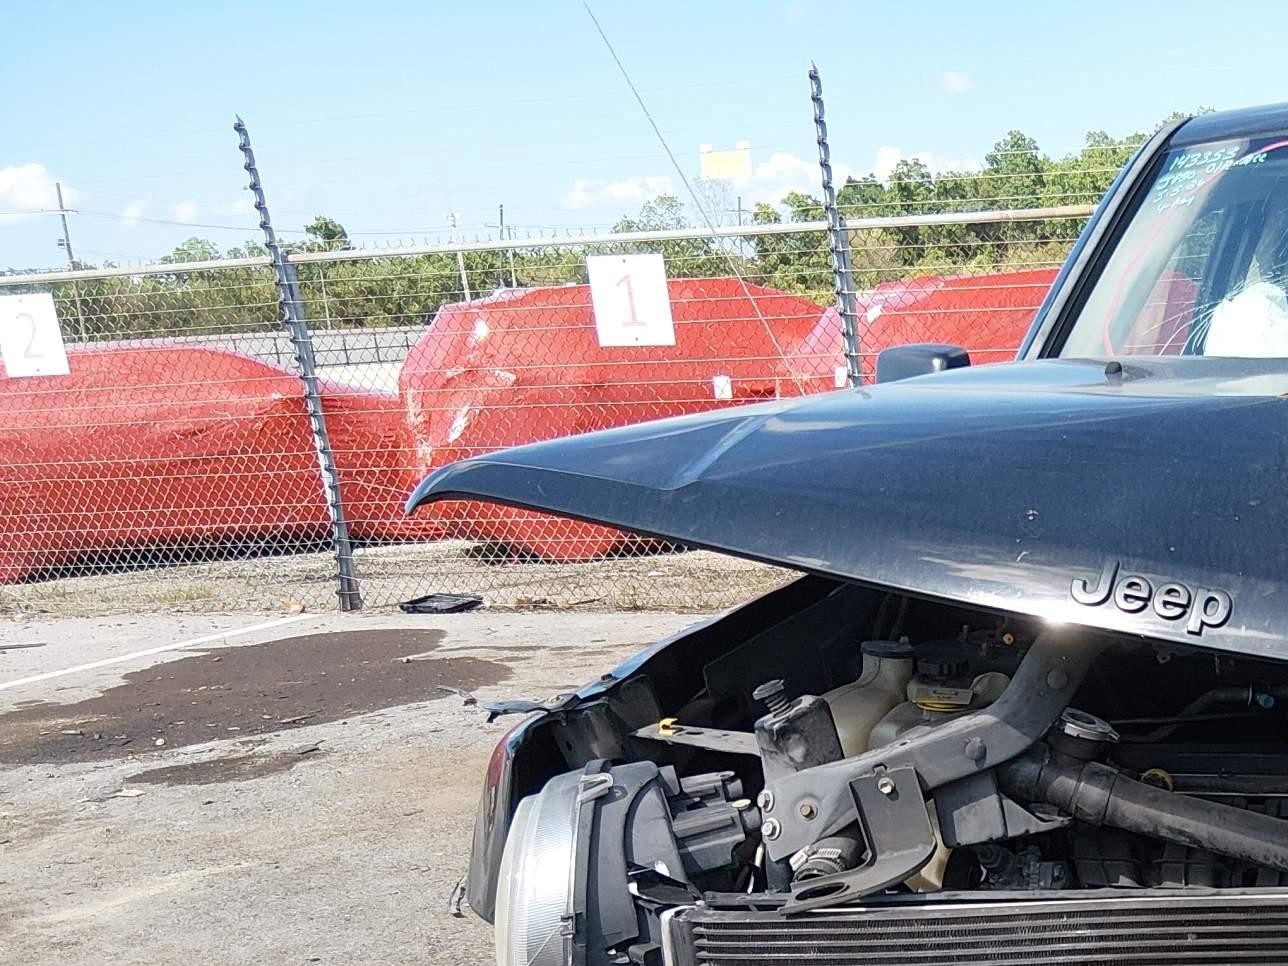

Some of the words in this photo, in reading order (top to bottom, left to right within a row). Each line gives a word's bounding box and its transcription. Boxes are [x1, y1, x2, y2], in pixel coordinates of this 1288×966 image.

[615, 274, 648, 328] 1
[15, 312, 47, 360] 2
[1070, 559, 1235, 637] Jeep
